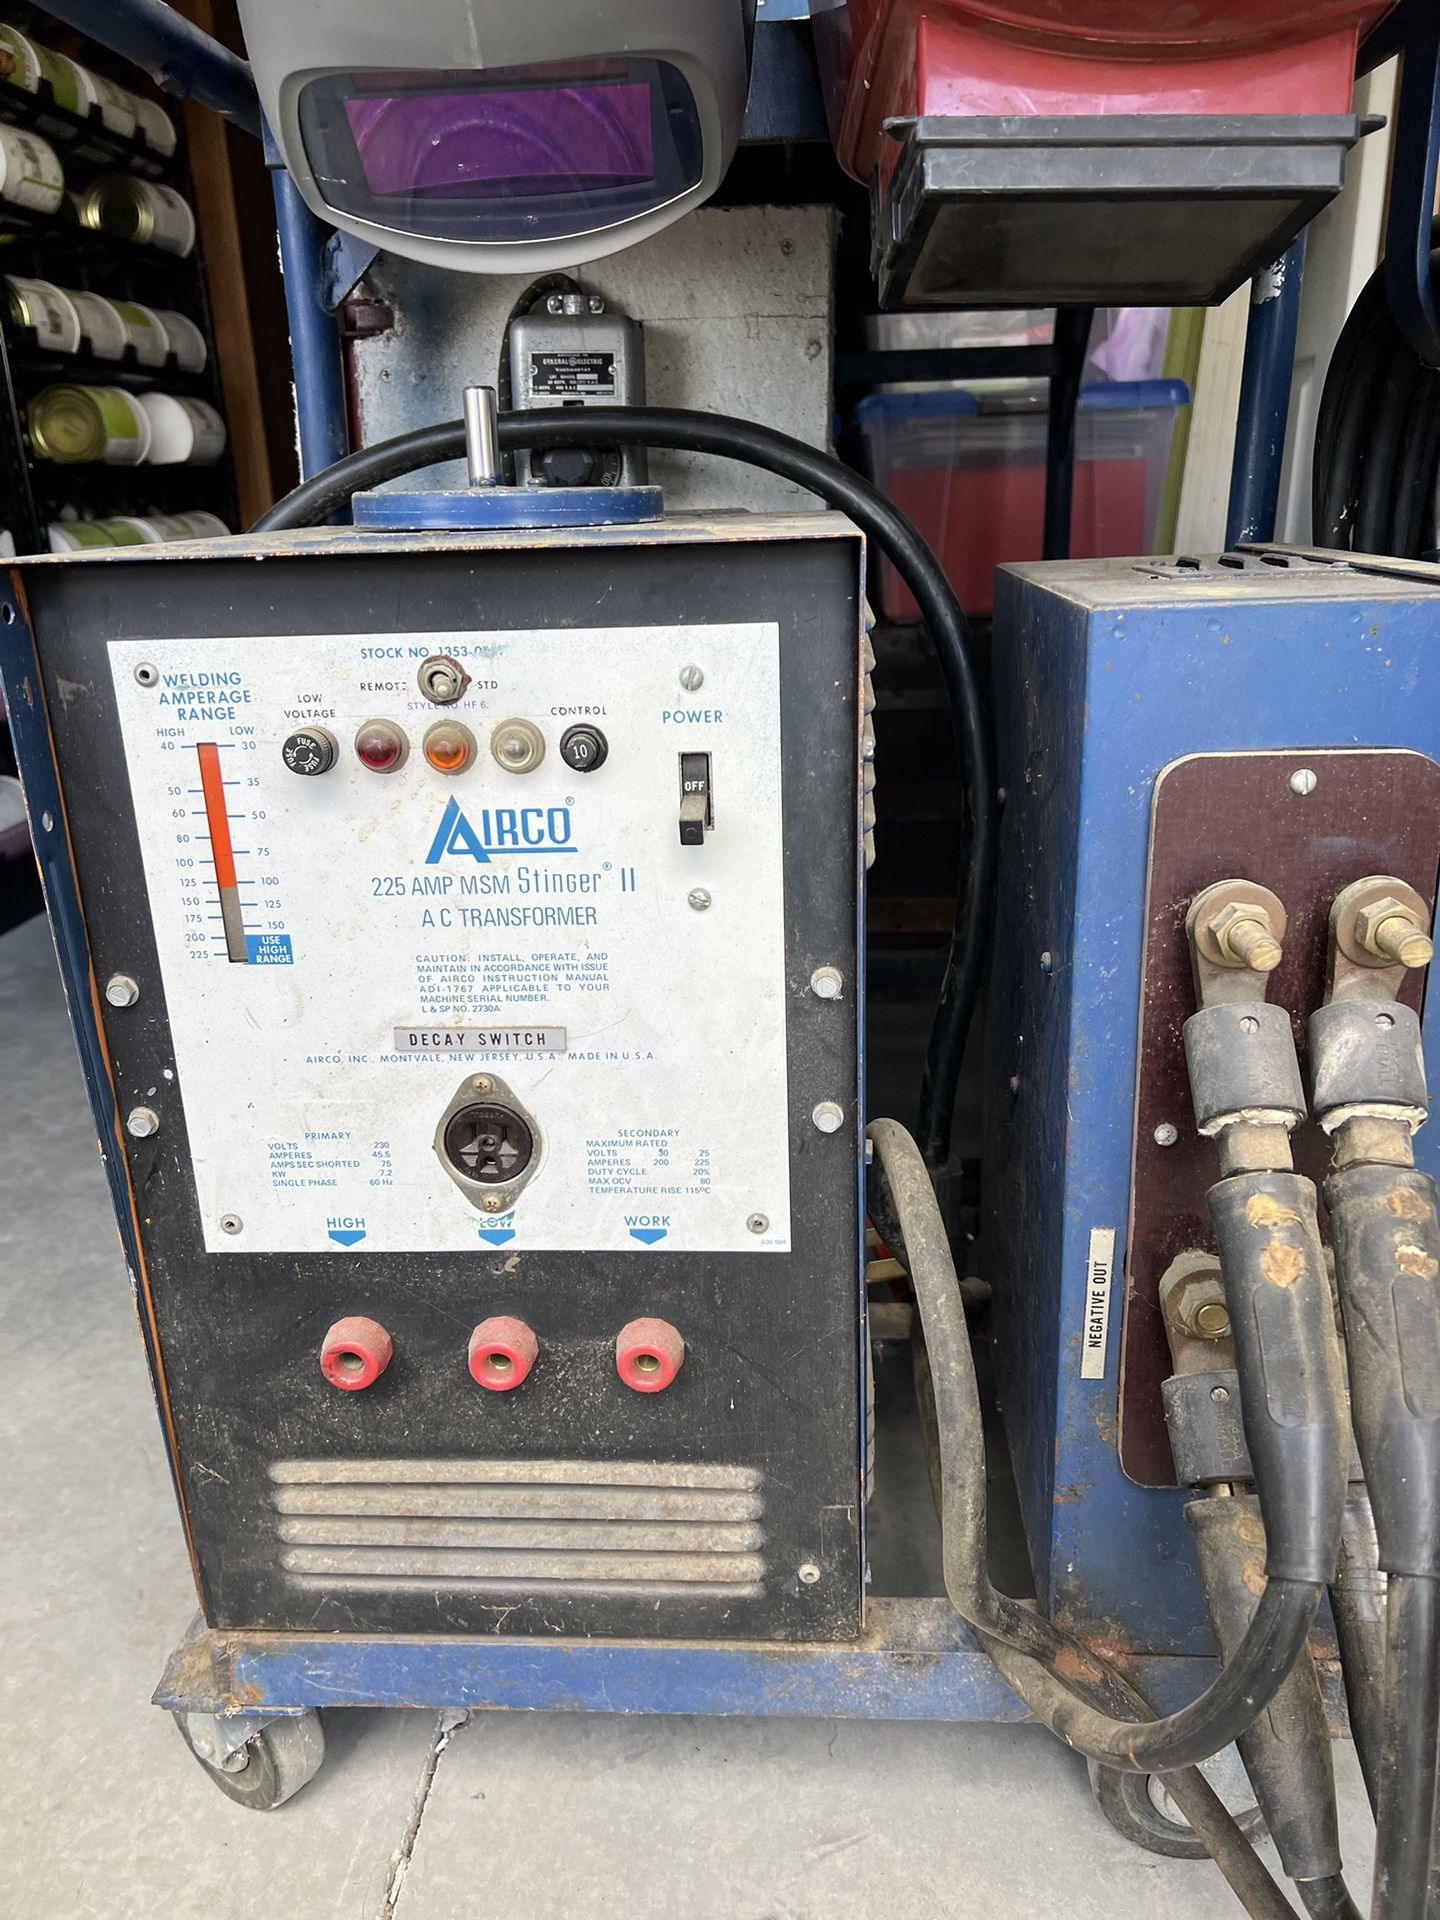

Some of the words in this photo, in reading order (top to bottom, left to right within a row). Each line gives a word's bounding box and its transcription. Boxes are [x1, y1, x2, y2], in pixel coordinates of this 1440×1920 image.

[361, 647, 403, 659] STOCK
[163, 672, 241, 687] WELDING
[477, 681, 498, 689] STD
[159, 690, 251, 705] AMPERAGE
[297, 694, 322, 703] LOW
[463, 702, 477, 710] HF
[551, 706, 607, 715] CONTROL
[177, 706, 236, 720] RANGE
[284, 709, 336, 718] VOLTAGE
[662, 710, 723, 724] POWER
[156, 728, 185, 737] HIGH
[229, 726, 254, 735] LOW
[160, 741, 175, 750] 40
[241, 741, 256, 750] 30
[297, 737, 317, 750] FUSE
[573, 744, 588, 759] 10
[285, 747, 297, 767] FUSE
[303, 756, 320, 772] FUSE
[247, 777, 260, 787] 35
[684, 781, 705, 791] OFF
[168, 786, 182, 795] 50
[172, 808, 186, 818] 60
[252, 811, 266, 820] 50
[176, 834, 190, 843] 80
[257, 847, 270, 856] 75
[176, 858, 194, 867] 100
[180, 878, 197, 887] 125
[261, 876, 279, 886] 100
[371, 877, 406, 896] 225
[411, 876, 453, 895] AMP
[460, 874, 510, 894] MSM
[621, 867, 635, 892] II
[181, 897, 200, 906] 150
[265, 900, 282, 909] 125
[185, 914, 202, 923] 175
[422, 909, 435, 928] A
[440, 908, 452, 927] C
[458, 906, 598, 927] TRANSFORMER
[268, 920, 285, 929] 150
[185, 933, 206, 942] 200
[261, 936, 280, 945] USE
[258, 945, 287, 954] HIGH
[190, 950, 209, 959] 225
[256, 955, 292, 963] RANGE
[478, 954, 525, 962] INSTALL,
[531, 953, 580, 962] OPERATE,
[587, 953, 608, 961] AND
[417, 964, 467, 973] MAINTAIN
[470, 964, 480, 972] IN
[484, 964, 551, 972] ACCORDANCE
[553, 963, 578, 971] WITH
[581, 963, 608, 971] ISSUE
[418, 975, 433, 983] OF
[440, 974, 475, 983] AIRCO
[483, 974, 558, 982] INSTRUCTION
[482, 984, 549, 992] APPLICABLE
[420, 995, 464, 1003] MACHINE
[467, 995, 503, 1003] SERIAL
[422, 1005, 428, 1013] L
[439, 1005, 450, 1013] SP
[472, 1005, 501, 1013] 2730A
[409, 1033, 465, 1046] DECAY
[478, 1033, 546, 1046] SWITCH
[380, 1054, 445, 1063] MONTVALE,
[449, 1054, 476, 1062] NEW
[568, 1052, 601, 1060] MADE
[605, 1052, 618, 1060] IN
[305, 1132, 351, 1140] PRIMARY
[618, 1129, 680, 1137] SECONDARY
[374, 1141, 390, 1149] 230
[635, 1139, 668, 1147] RATED
[587, 1149, 618, 1157] VOLTS
[699, 1149, 710, 1157] 25
[316, 1160, 361, 1168] SHORTED
[653, 1158, 669, 1166] 200
[380, 1169, 393, 1177] 7.2
[588, 1168, 614, 1176] DUTY
[616, 1168, 647, 1176] CYCLE
[693, 1168, 710, 1176] 20%
[272, 1179, 306, 1187] SINGLE
[700, 1177, 711, 1185] 80
[326, 1217, 365, 1229] HIGH
[480, 1217, 512, 1228] LOW
[624, 1215, 671, 1227] WORK
[1093, 1261, 1108, 1285] OUT
[1088, 1290, 1105, 1348] NEGATIVE
